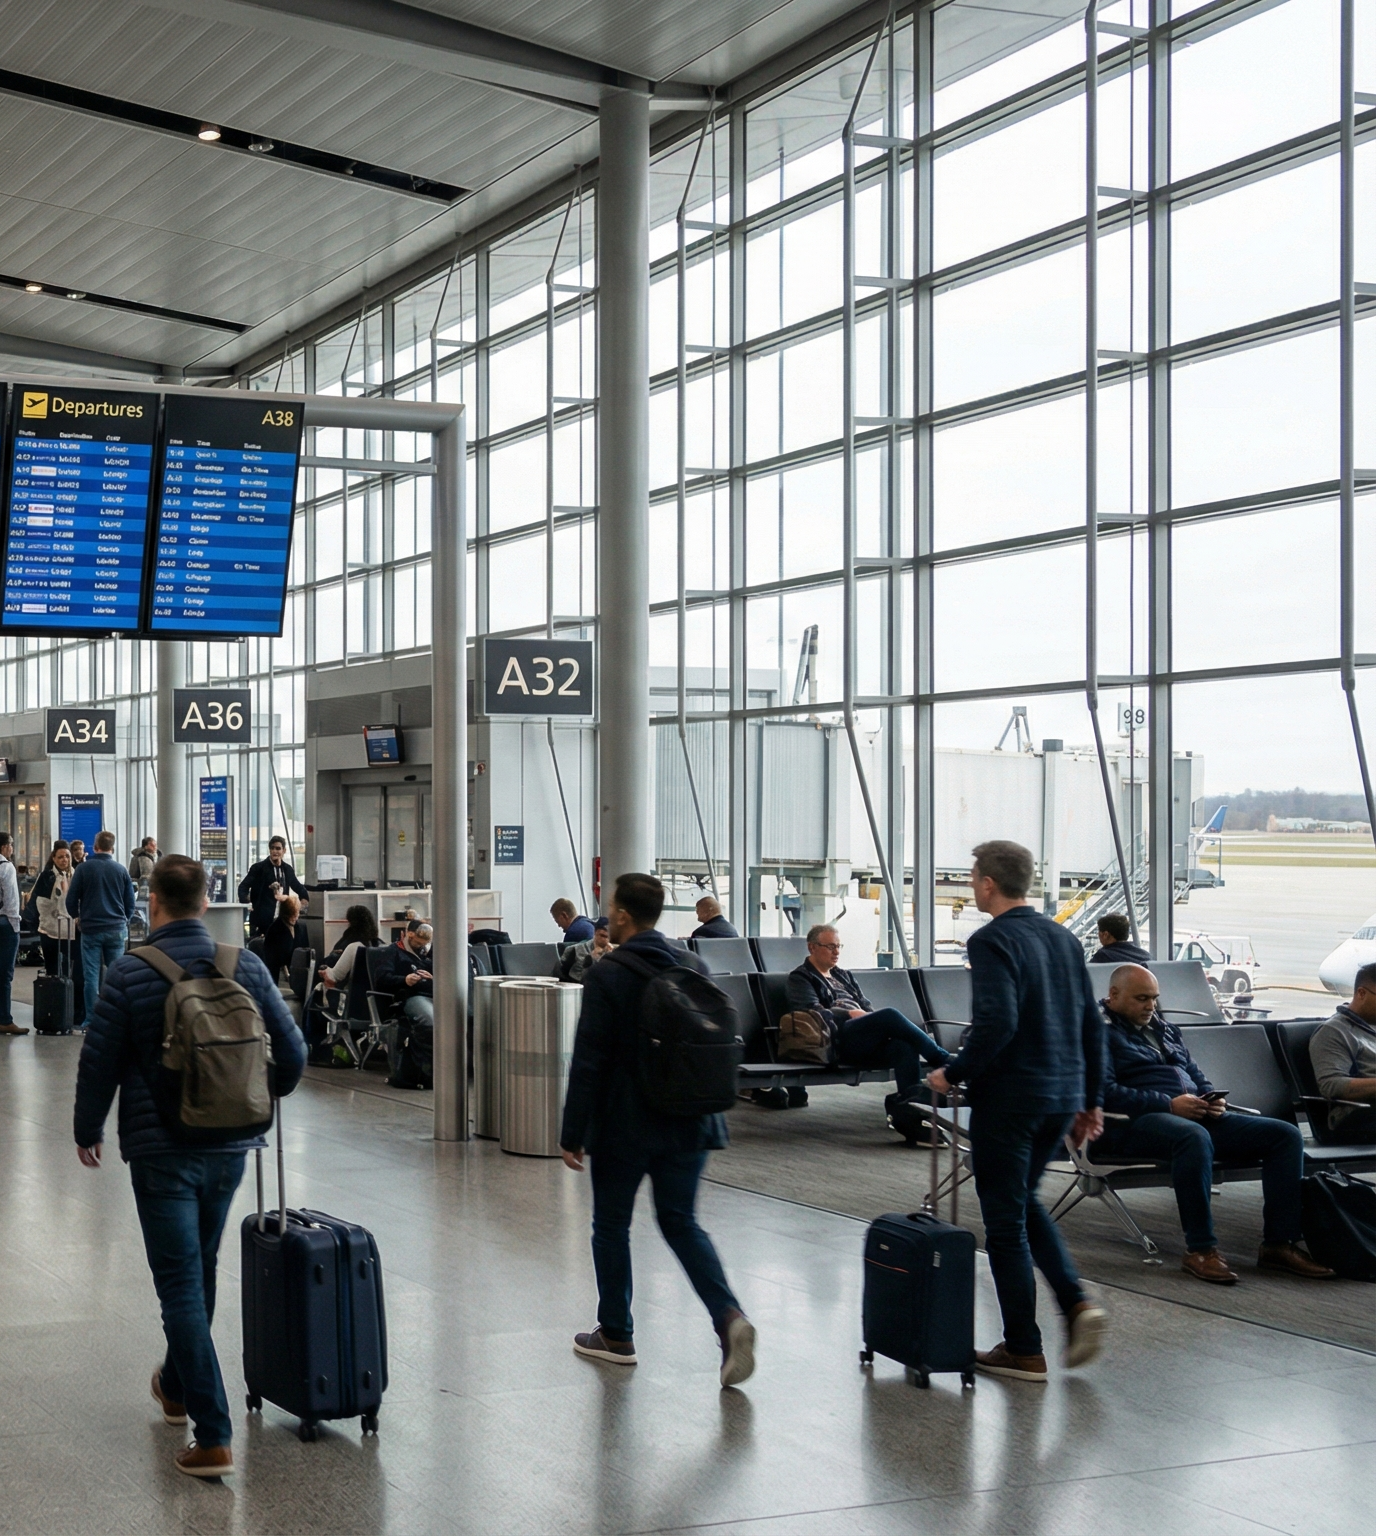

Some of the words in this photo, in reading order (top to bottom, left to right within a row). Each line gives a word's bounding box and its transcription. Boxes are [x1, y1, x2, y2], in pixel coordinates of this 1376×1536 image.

[52, 397, 144, 419] Departures
[261, 410, 294, 427] A38
[496, 656, 581, 696] A32
[181, 701, 244, 731] A36
[1123, 708, 1145, 725] 98
[53, 718, 109, 744] A34
